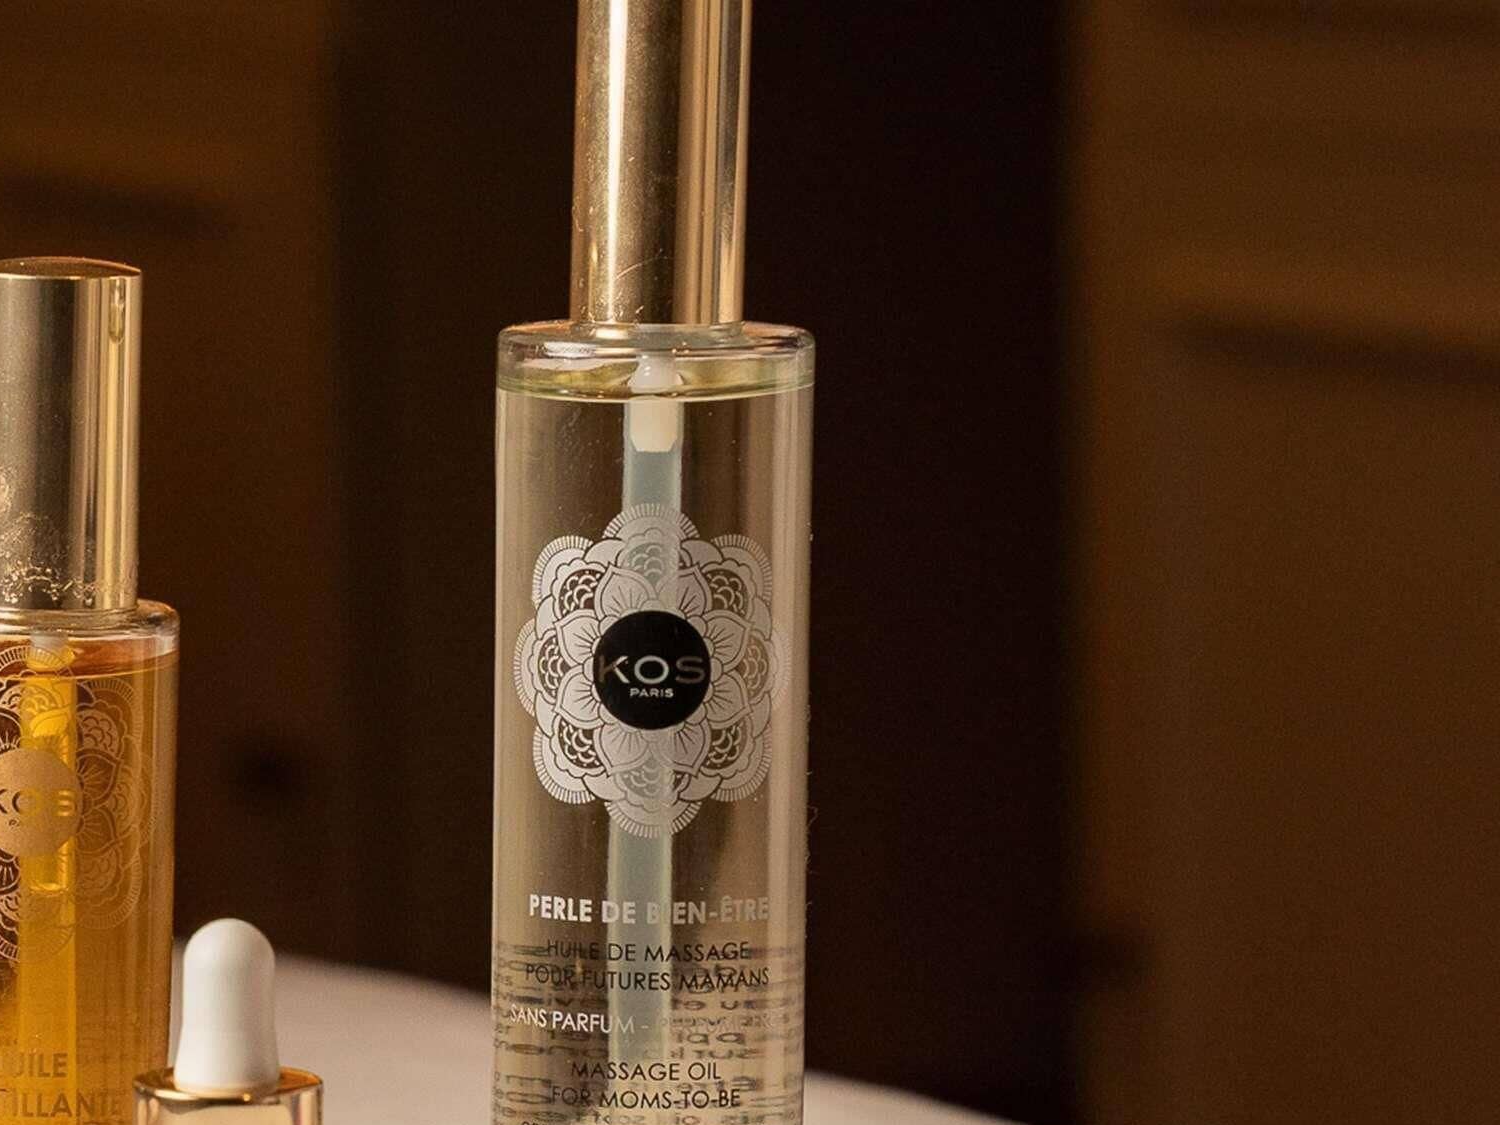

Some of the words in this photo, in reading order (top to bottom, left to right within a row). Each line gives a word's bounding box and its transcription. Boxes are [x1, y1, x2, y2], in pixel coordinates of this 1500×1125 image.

[599, 655, 706, 685] KOS
[629, 687, 675, 699] PARIS
[529, 894, 592, 923] PERLE
[601, 899, 636, 925] DE
[646, 896, 769, 925] BEN-ÊTRE
[546, 939, 598, 961] HUILE
[607, 943, 636, 962] DE
[644, 941, 750, 963] MASSAGE
[525, 963, 576, 988] POUR
[583, 970, 671, 991] FUTURES
[678, 966, 769, 991] MAMANS
[508, 1003, 547, 1028] SANS
[551, 1010, 635, 1034] PARFUM
[571, 1061, 681, 1082] MASSAGE
[688, 1062, 722, 1081] OIL
[551, 1086, 591, 1106] FOR
[600, 1088, 741, 1110] MOMS-TO-BE
